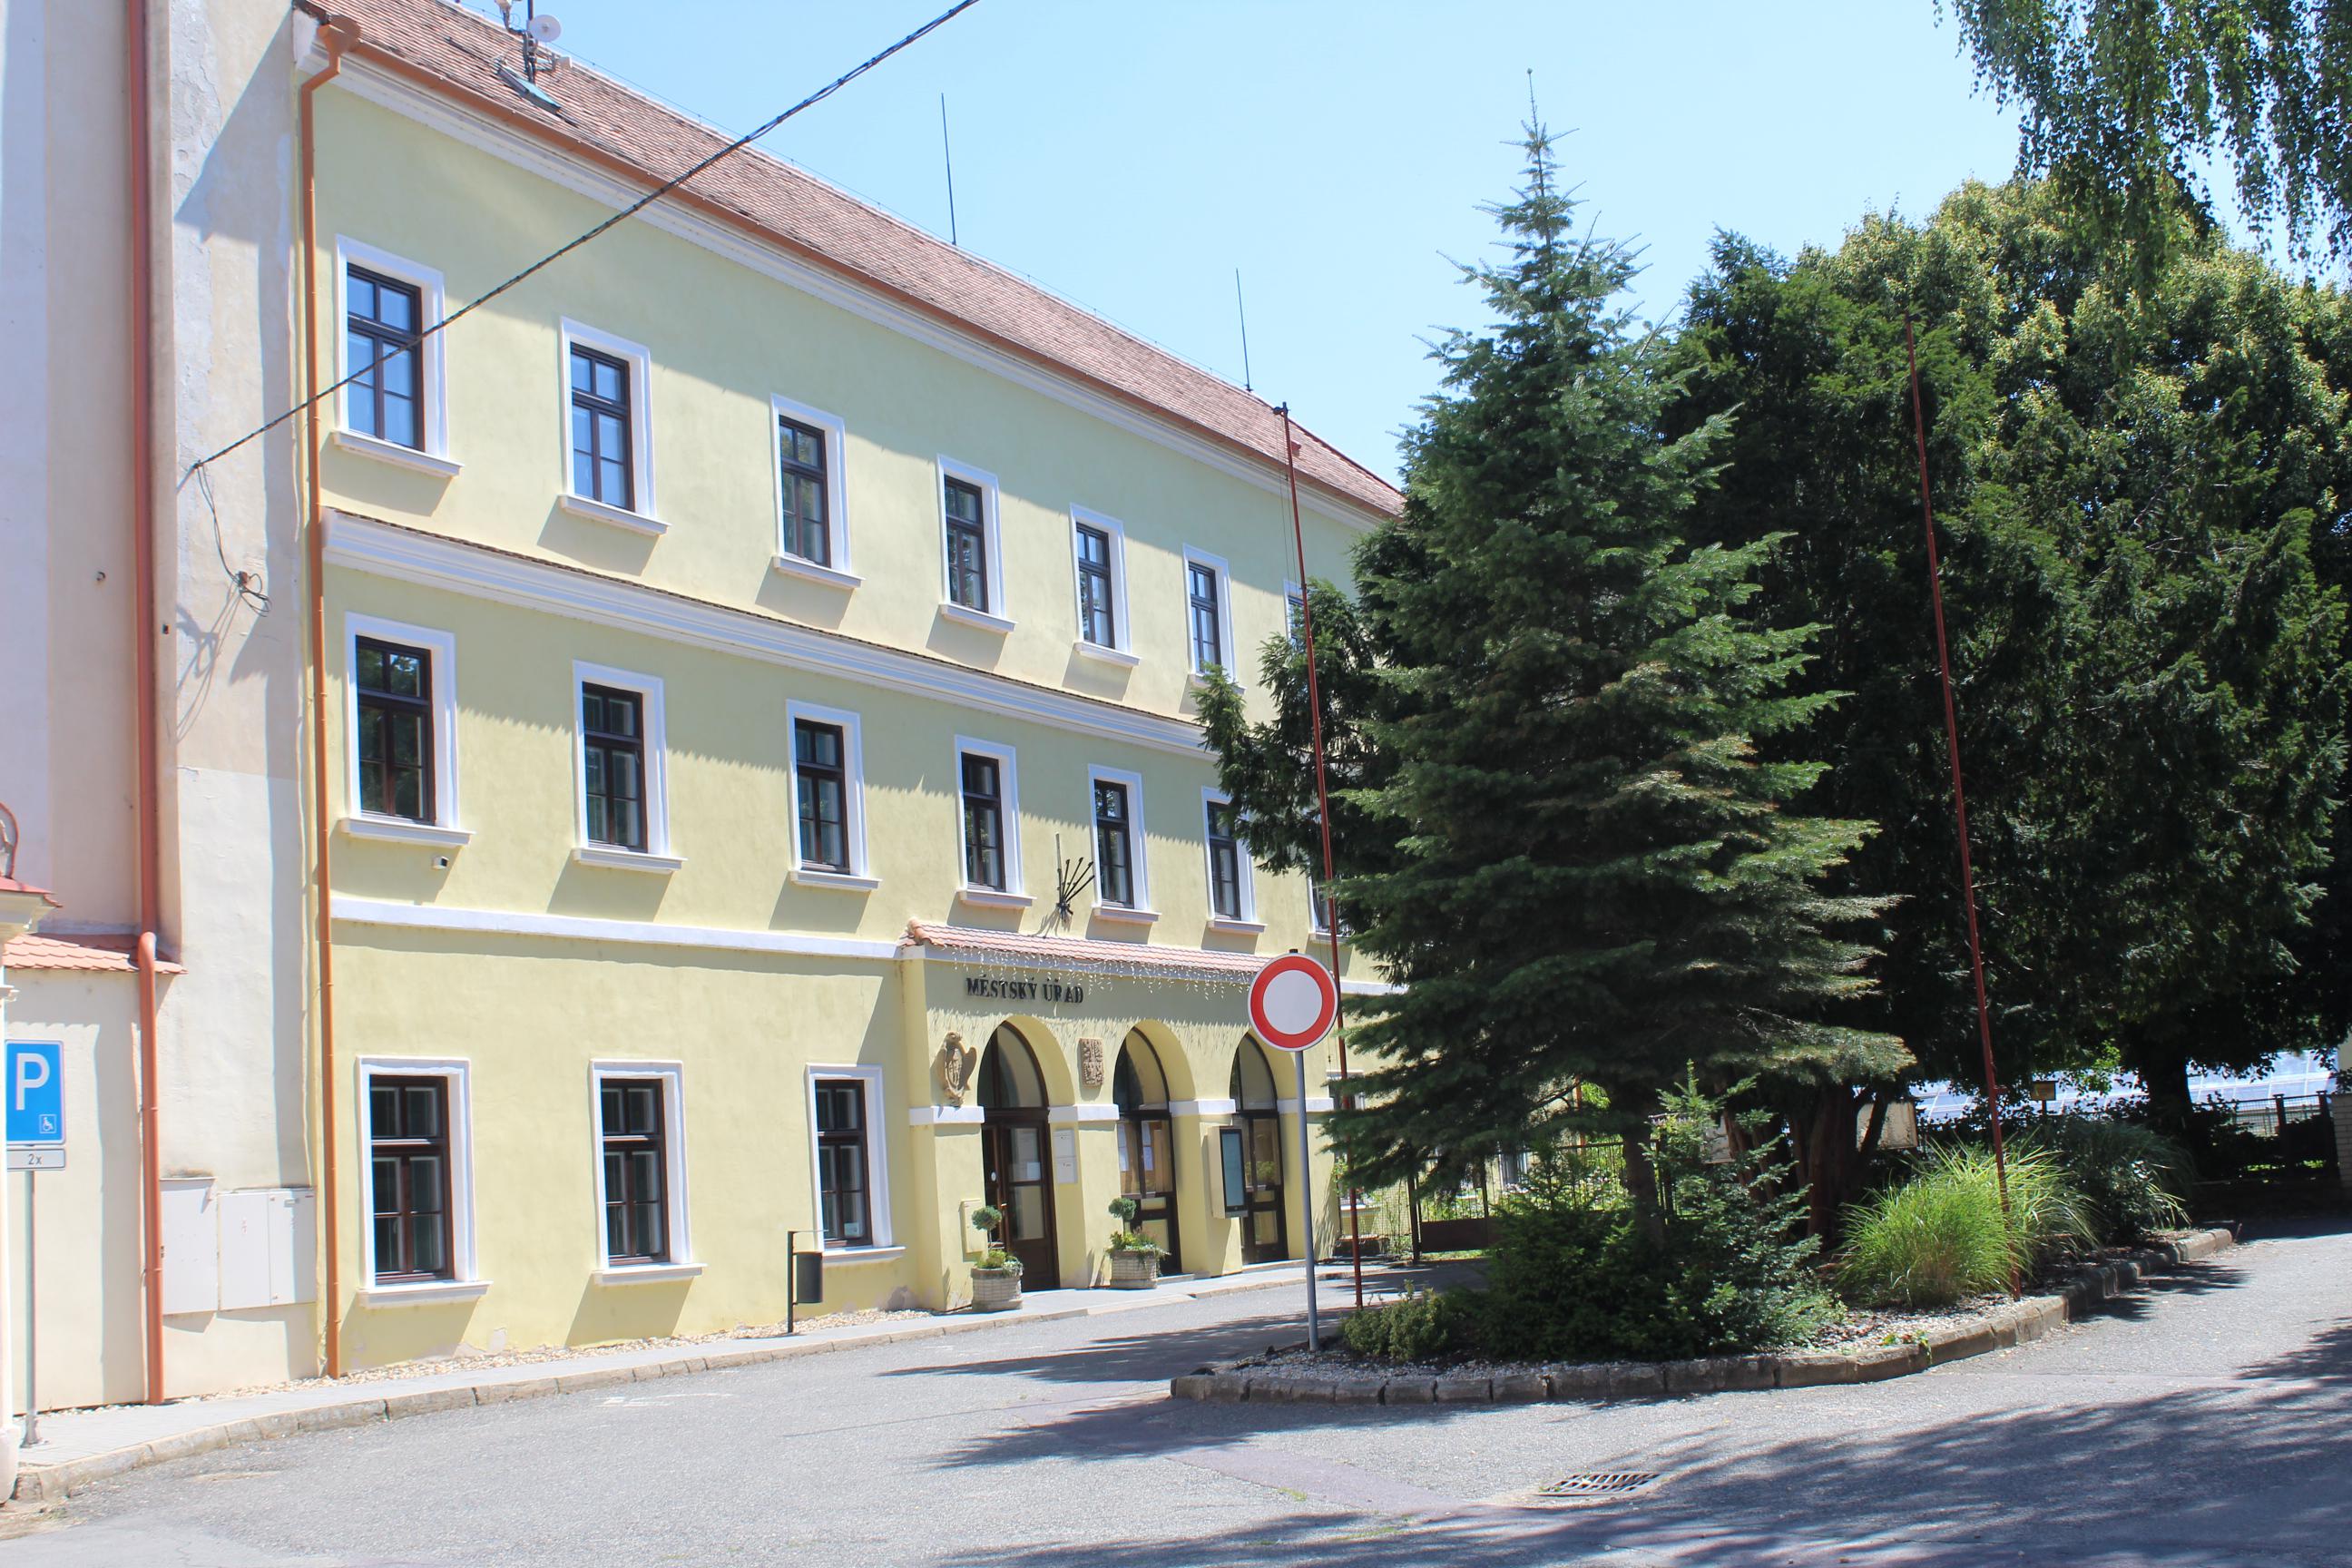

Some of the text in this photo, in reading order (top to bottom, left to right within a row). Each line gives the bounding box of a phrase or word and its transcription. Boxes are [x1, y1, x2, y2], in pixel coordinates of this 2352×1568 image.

[966, 975, 1084, 1003] MĚSTSKÝ ÚŘAD
[15, 1053, 50, 1111] P
[28, 1153, 42, 1165] 2x
